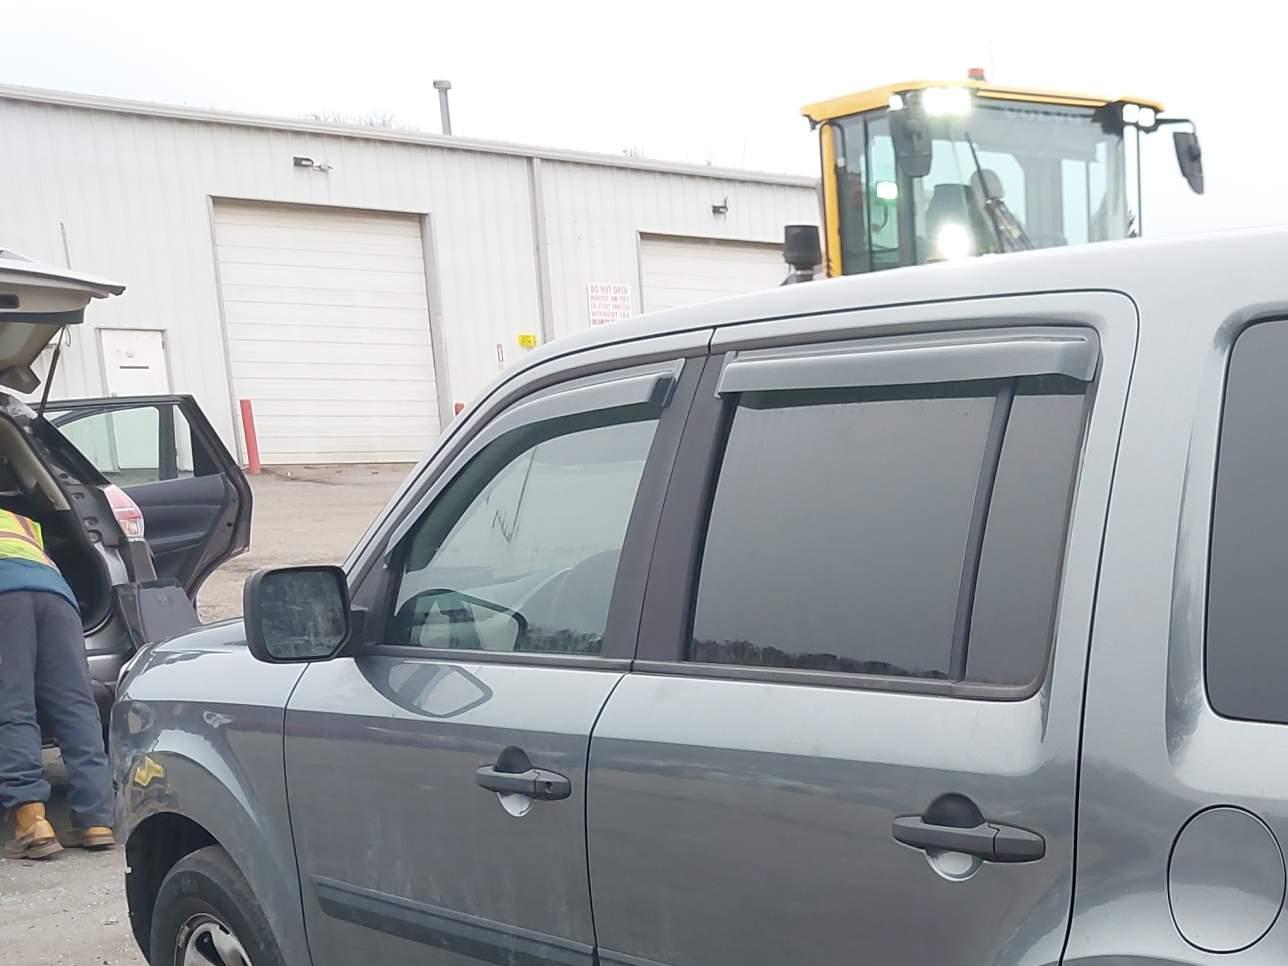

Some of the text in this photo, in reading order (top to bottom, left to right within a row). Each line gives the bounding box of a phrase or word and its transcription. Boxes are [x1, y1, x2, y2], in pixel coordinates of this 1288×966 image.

[590, 285, 628, 295] DO NOT OPEN
